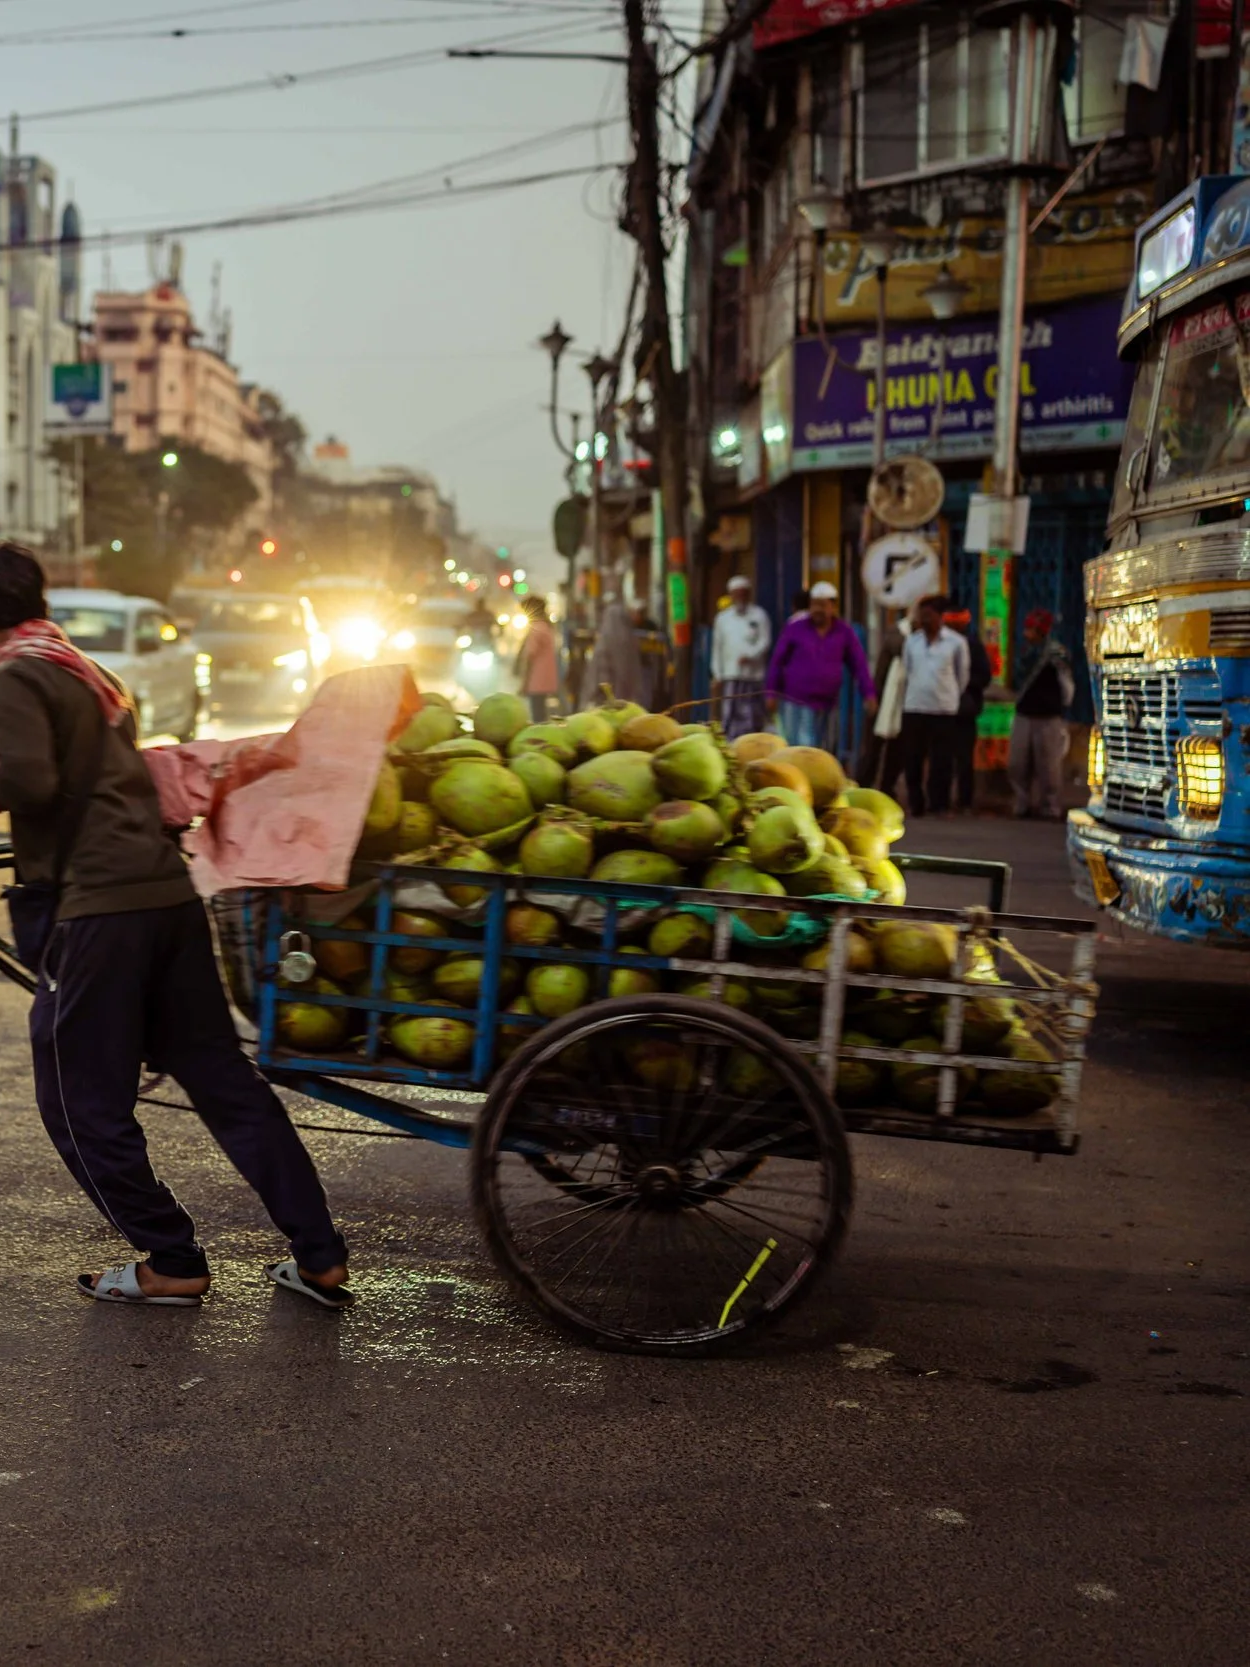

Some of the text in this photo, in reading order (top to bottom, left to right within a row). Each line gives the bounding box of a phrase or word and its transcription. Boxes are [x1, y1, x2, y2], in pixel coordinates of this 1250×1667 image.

[855, 320, 1053, 371] Baidyanth
[984, 361, 1036, 399] OL
[805, 421, 844, 443] Quick
